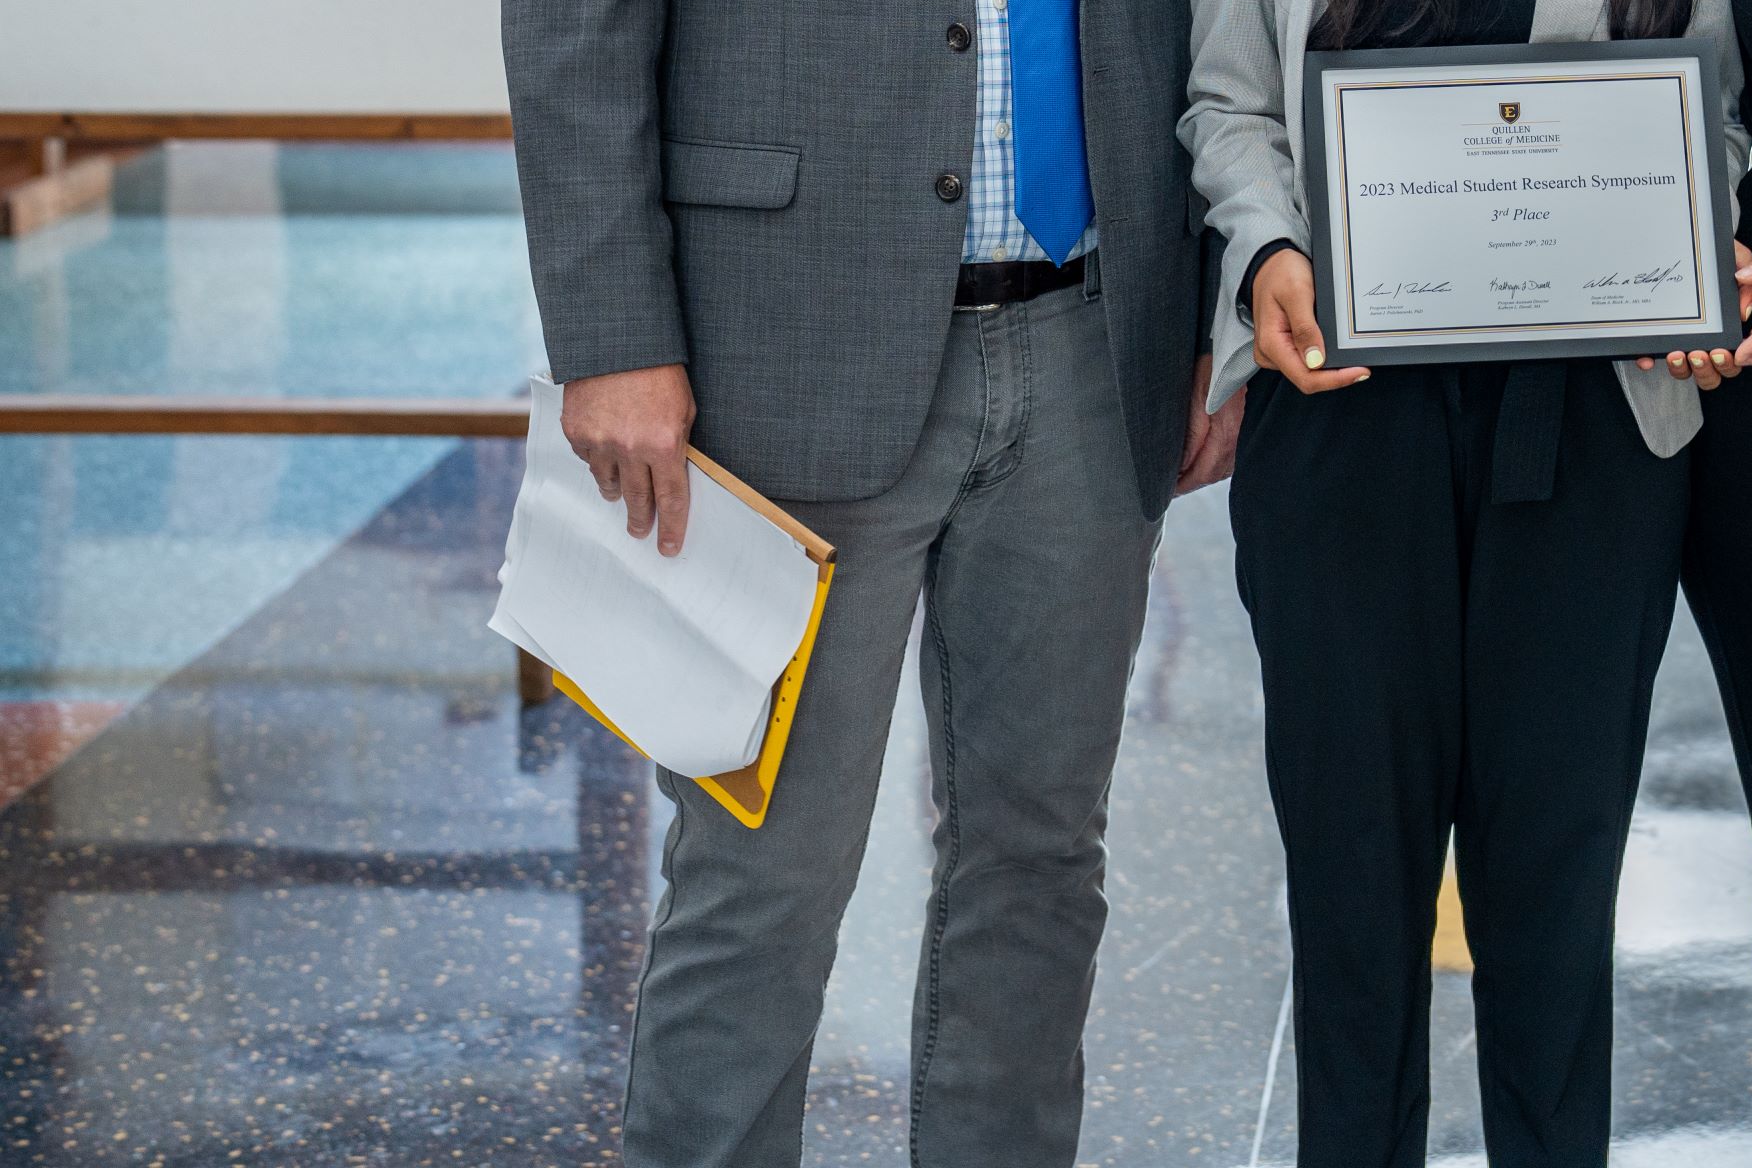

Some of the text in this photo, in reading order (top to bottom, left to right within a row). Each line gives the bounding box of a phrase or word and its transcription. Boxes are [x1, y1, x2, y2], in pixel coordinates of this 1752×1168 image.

[1504, 106, 1516, 118] E
[1492, 125, 1531, 134] QUILLEN
[1463, 134, 1561, 146] COLLEGE of MEDICINE
[1360, 172, 1676, 197] 2023 Medical Student Research Symposium
[1491, 208, 1551, 222] 3rd Place
[1488, 240, 1523, 250] September
